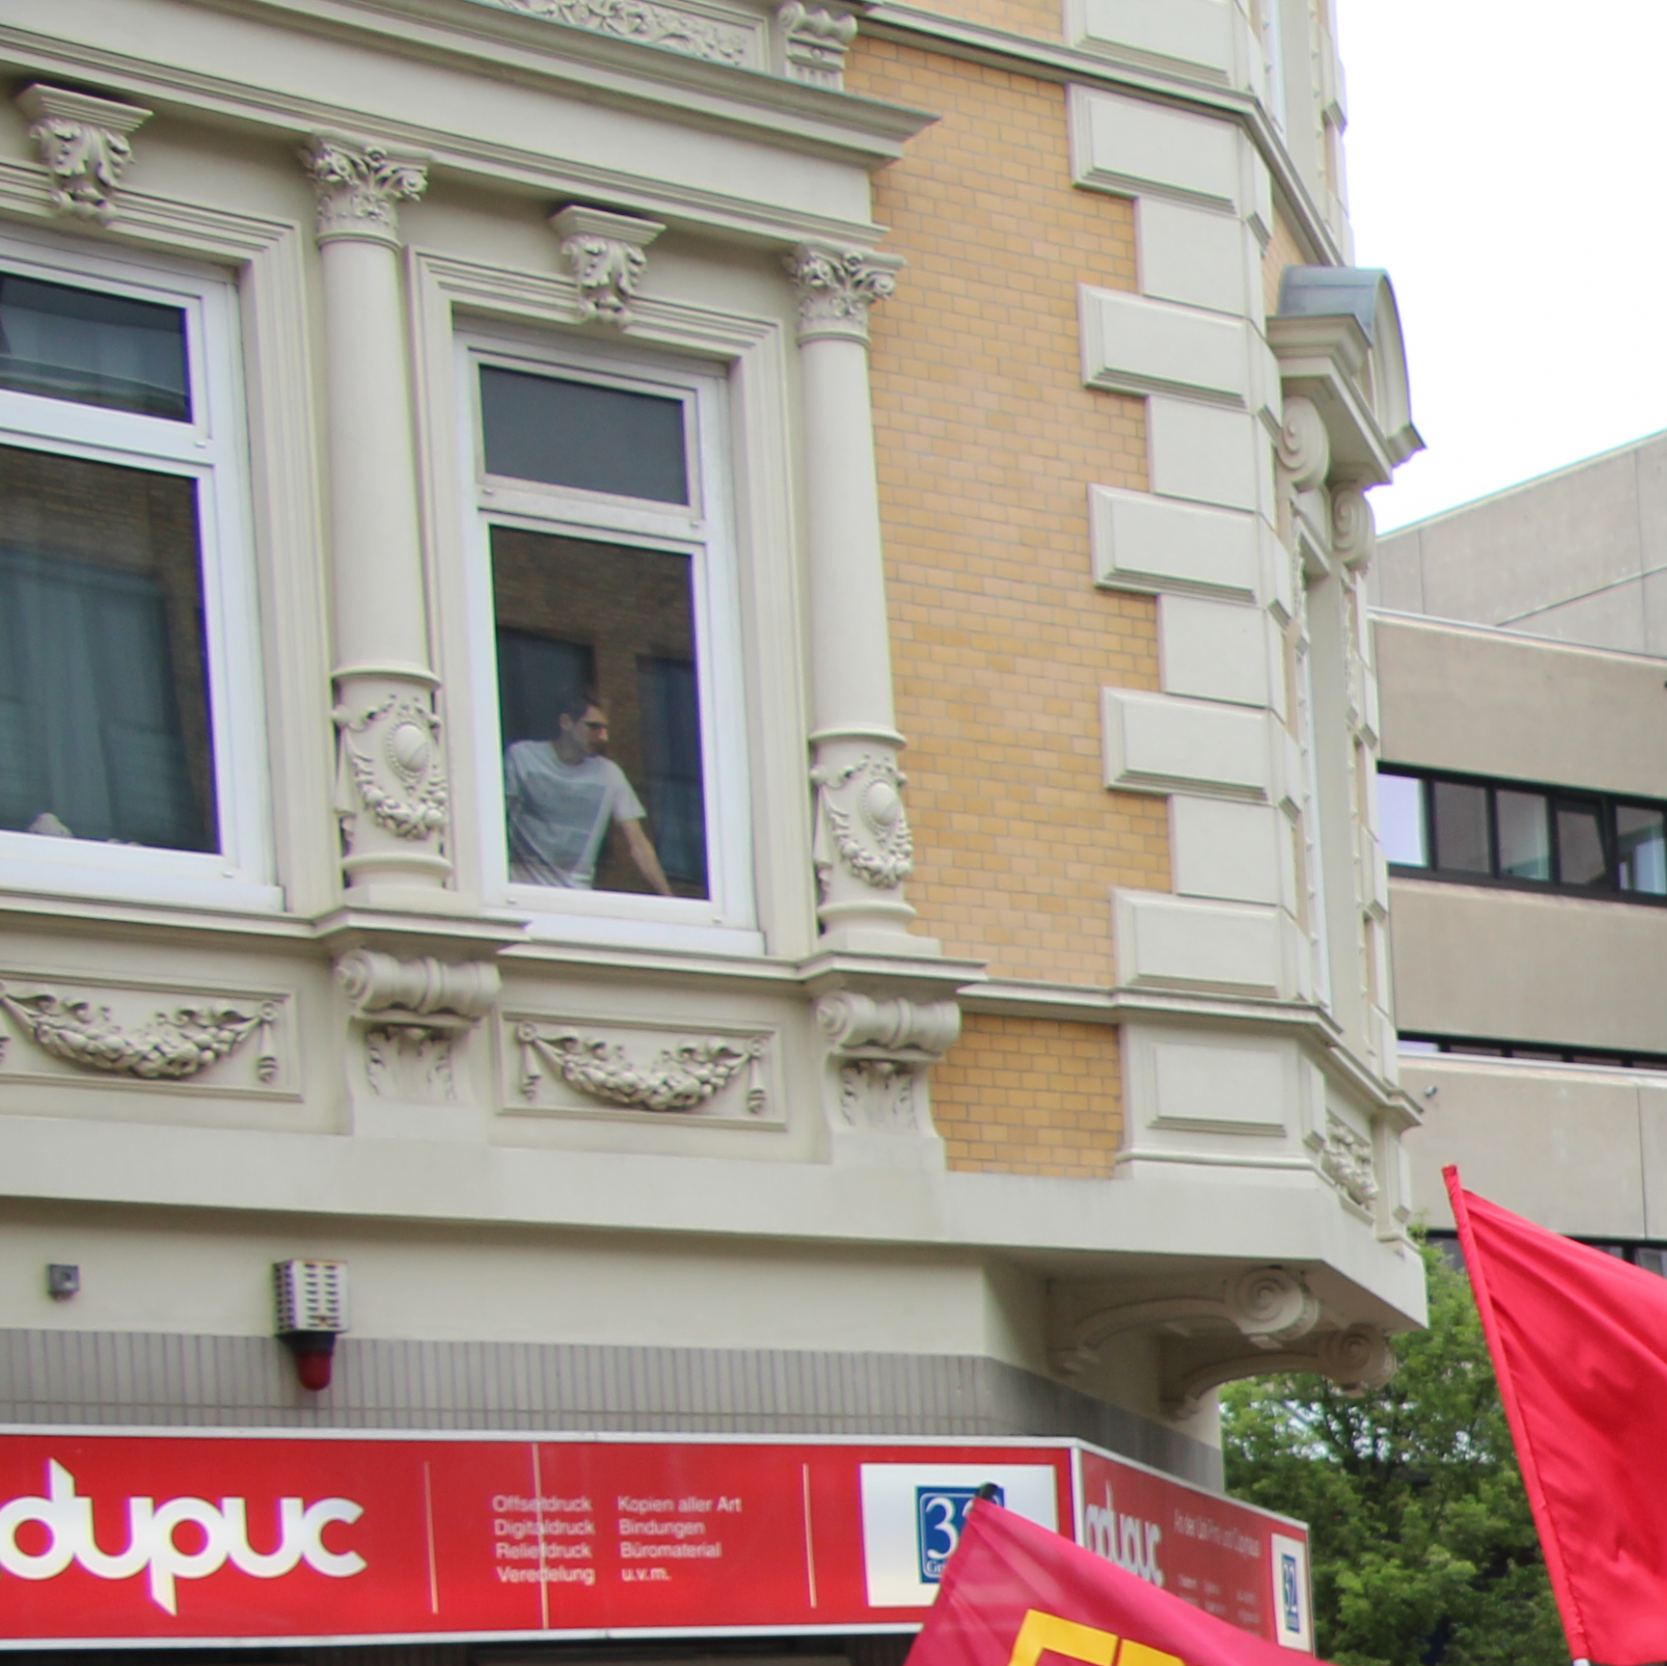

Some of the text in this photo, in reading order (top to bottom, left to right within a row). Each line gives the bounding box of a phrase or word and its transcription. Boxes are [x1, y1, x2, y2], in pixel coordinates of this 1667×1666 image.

[492, 1496, 592, 1512] Offsetdruck
[618, 1496, 743, 1514] Kopien aller Art
[494, 1519, 596, 1538] Digitaldruck
[619, 1518, 705, 1537] Bindungen
[496, 1542, 593, 1559] Reliefdruck
[620, 1542, 722, 1559] Büromaterial
[497, 1566, 595, 1585] Veredelung
[622, 1568, 671, 1581] u.v.m.
